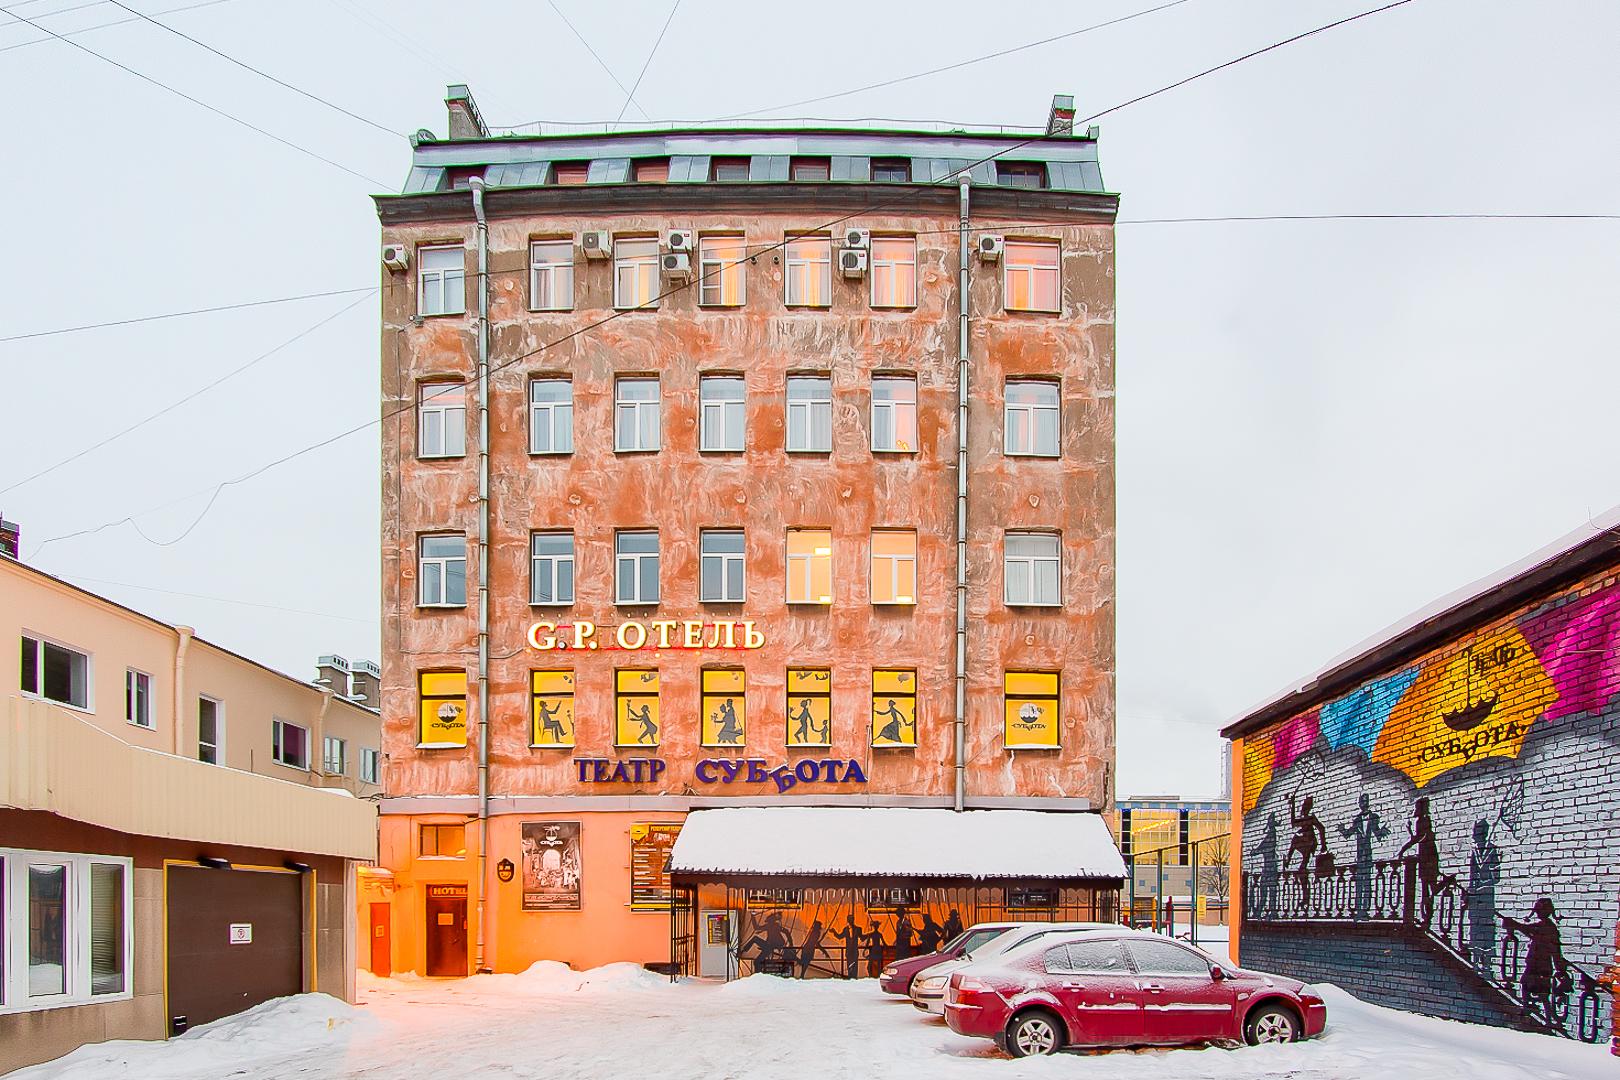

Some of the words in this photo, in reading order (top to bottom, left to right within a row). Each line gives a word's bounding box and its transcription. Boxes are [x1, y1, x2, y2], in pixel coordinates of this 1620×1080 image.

[527, 620, 598, 650] G.P.
[616, 620, 766, 649] ОТЕЛЬ
[573, 757, 666, 783] ТЕАТР
[695, 757, 869, 793] СУББОТА
[432, 887, 467, 895] HOTEL
